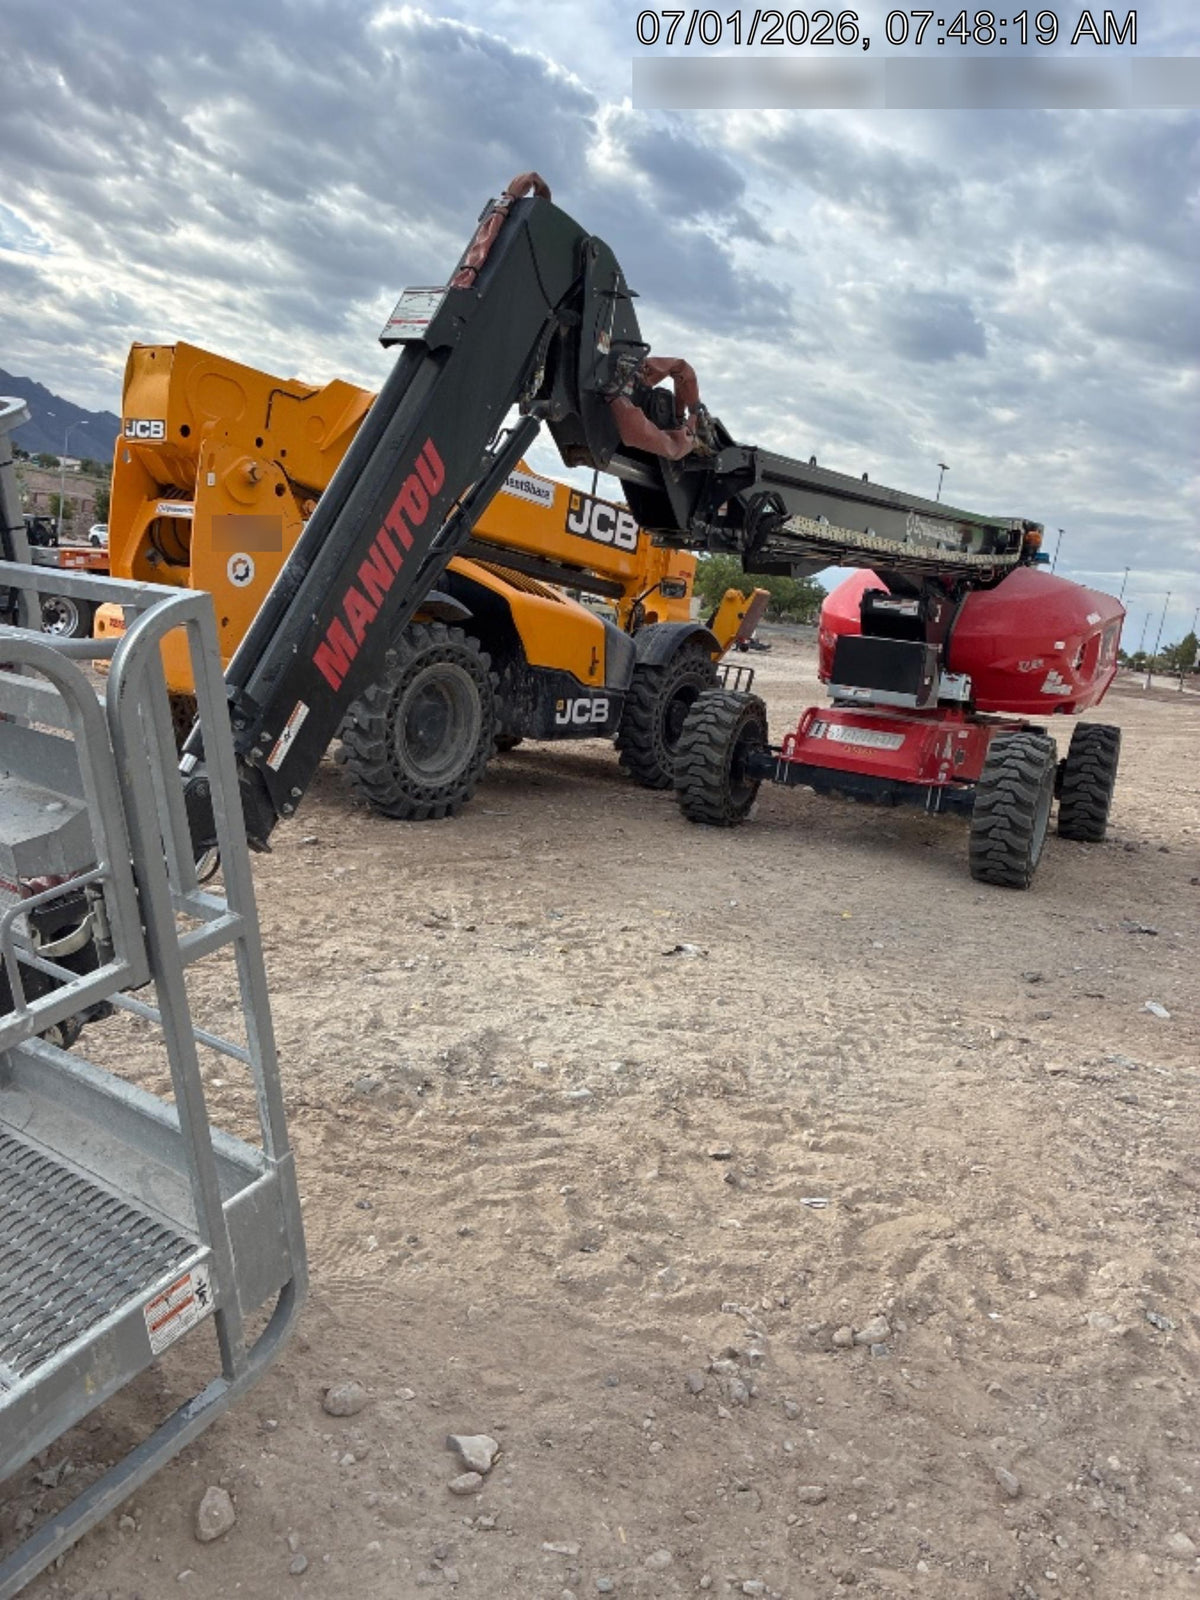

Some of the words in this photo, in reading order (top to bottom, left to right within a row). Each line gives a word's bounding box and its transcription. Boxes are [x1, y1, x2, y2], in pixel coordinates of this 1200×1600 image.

[125, 420, 165, 438] JCB
[568, 498, 640, 550] JCB
[312, 437, 446, 693] MANITOU
[555, 698, 609, 725] JCB
